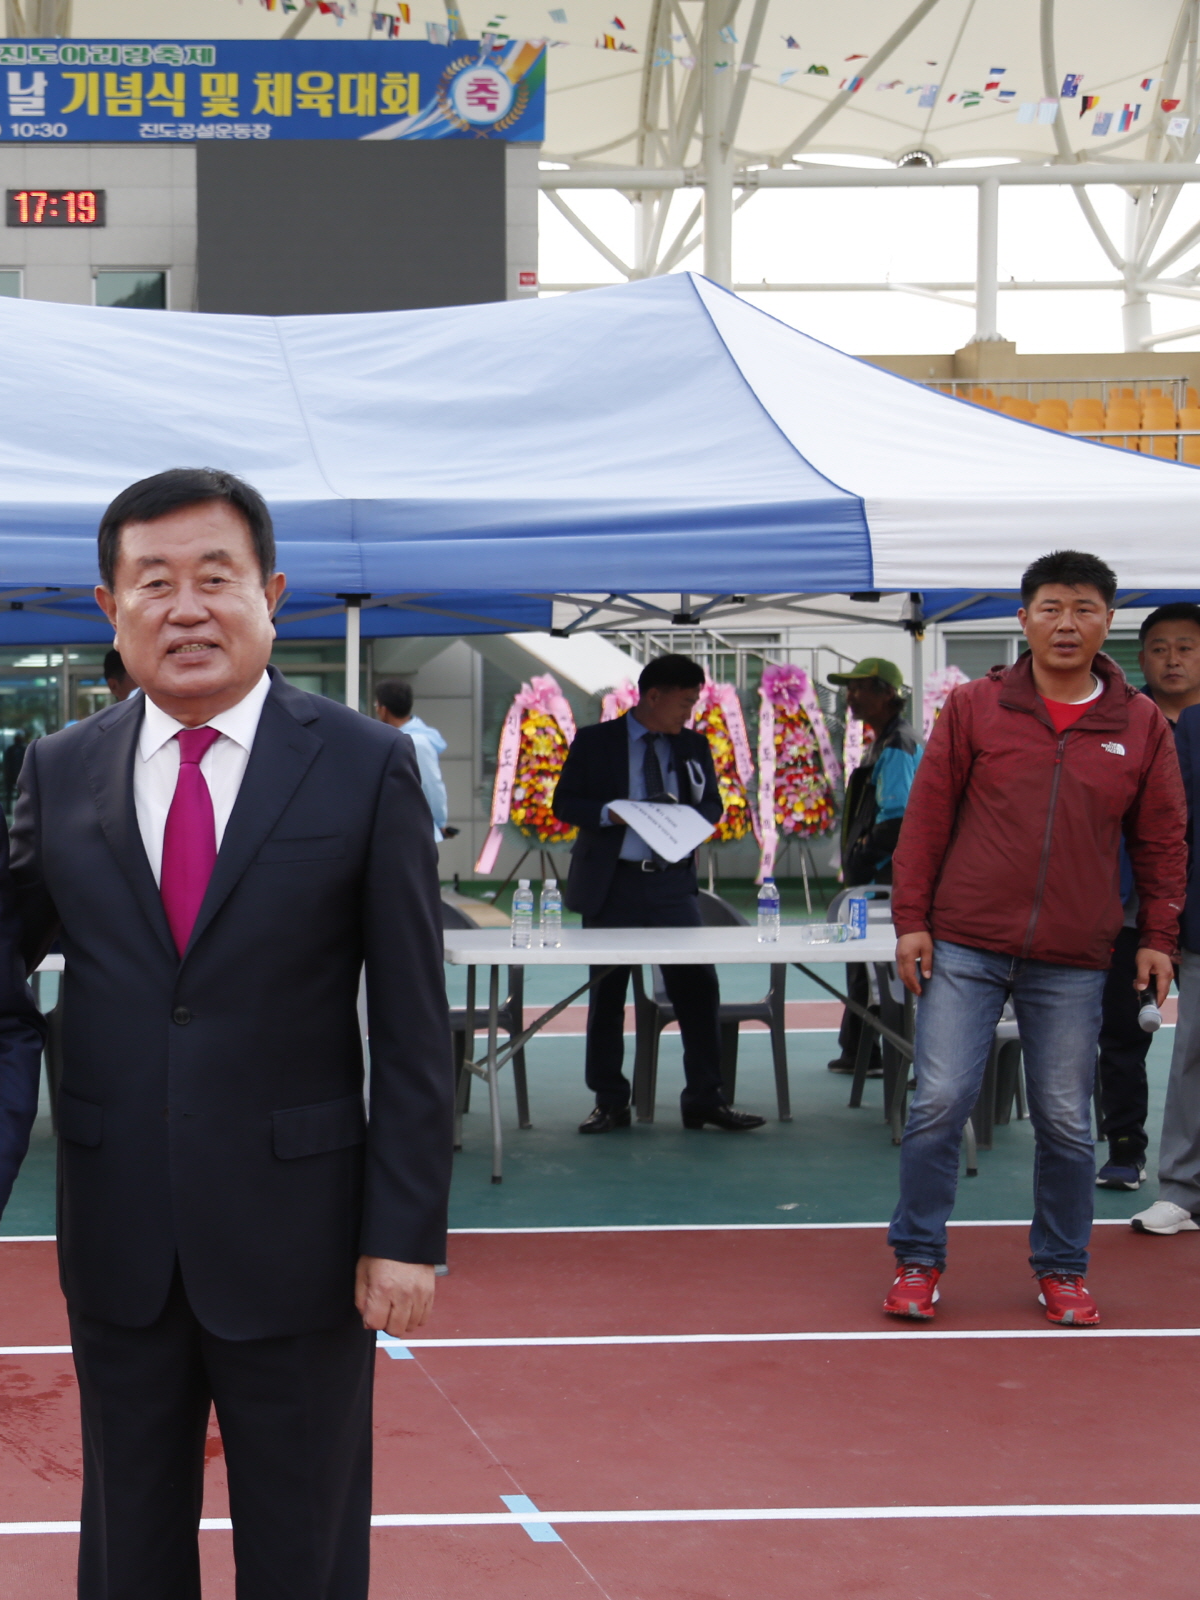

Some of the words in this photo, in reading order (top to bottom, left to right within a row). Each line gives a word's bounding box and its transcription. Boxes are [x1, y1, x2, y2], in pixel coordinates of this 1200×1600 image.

[7, 71, 48, 117] 날
[60, 72, 187, 118] 기념식
[200, 73, 241, 118] 및
[251, 72, 421, 118] 체육대회
[466, 77, 500, 112] 축
[10, 123, 68, 139] 10:30
[138, 123, 272, 140] 진도공설운동장
[13, 191, 97, 223] 17:19
